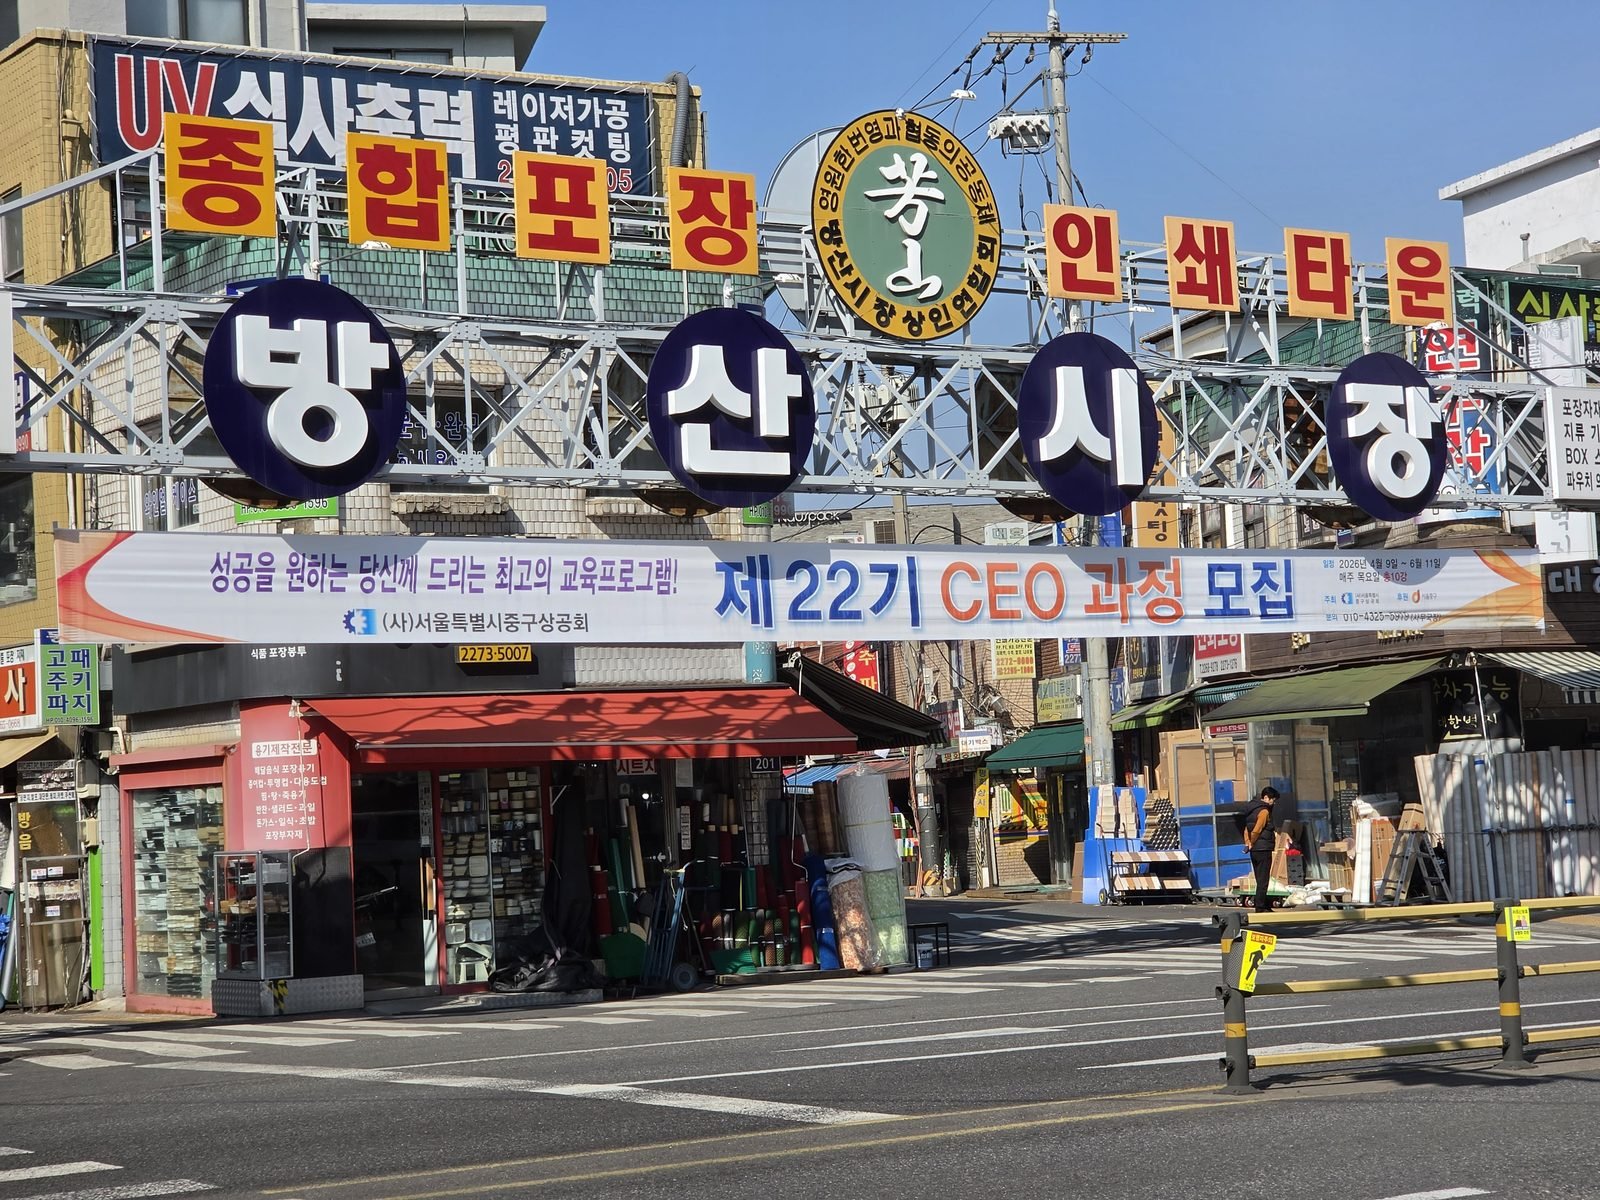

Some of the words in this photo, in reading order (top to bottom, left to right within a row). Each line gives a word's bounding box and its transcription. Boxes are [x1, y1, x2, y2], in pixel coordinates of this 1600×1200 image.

[115, 53, 218, 152] UV
[493, 90, 629, 130] 레이저가공
[818, 147, 855, 213] 영원한
[848, 116, 901, 152] 번영과
[905, 119, 962, 165] 협동의
[956, 156, 997, 226] 공동체
[819, 218, 898, 328] 방산시장
[902, 234, 998, 338] 상인연합회
[1564, 422, 1585, 442] 지류
[1566, 447, 1589, 464] BOX
[1567, 470, 1593, 491] 파우치
[210, 551, 276, 593] 성공을
[286, 552, 348, 593] 원하는
[359, 553, 419, 595] 당신께
[426, 555, 485, 595] 드리는
[495, 555, 552, 595] 최고의
[560, 556, 678, 596] 교육프로그램!
[1322, 559, 1335, 569] 일정
[1339, 558, 1367, 569] 2026년
[1370, 558, 1383, 569] 4월
[1385, 558, 1398, 569] 9일
[1409, 558, 1422, 569] 6월
[1425, 558, 1441, 569] 11일
[1339, 572, 1354, 583] 매주
[1357, 572, 1380, 583] 목요일
[940, 560, 1064, 622] CEO
[1083, 556, 1183, 625] 과정
[1203, 557, 1295, 622] 모집
[255, 740, 313, 757] 용기제작전문
[756, 757, 775, 770] 201
